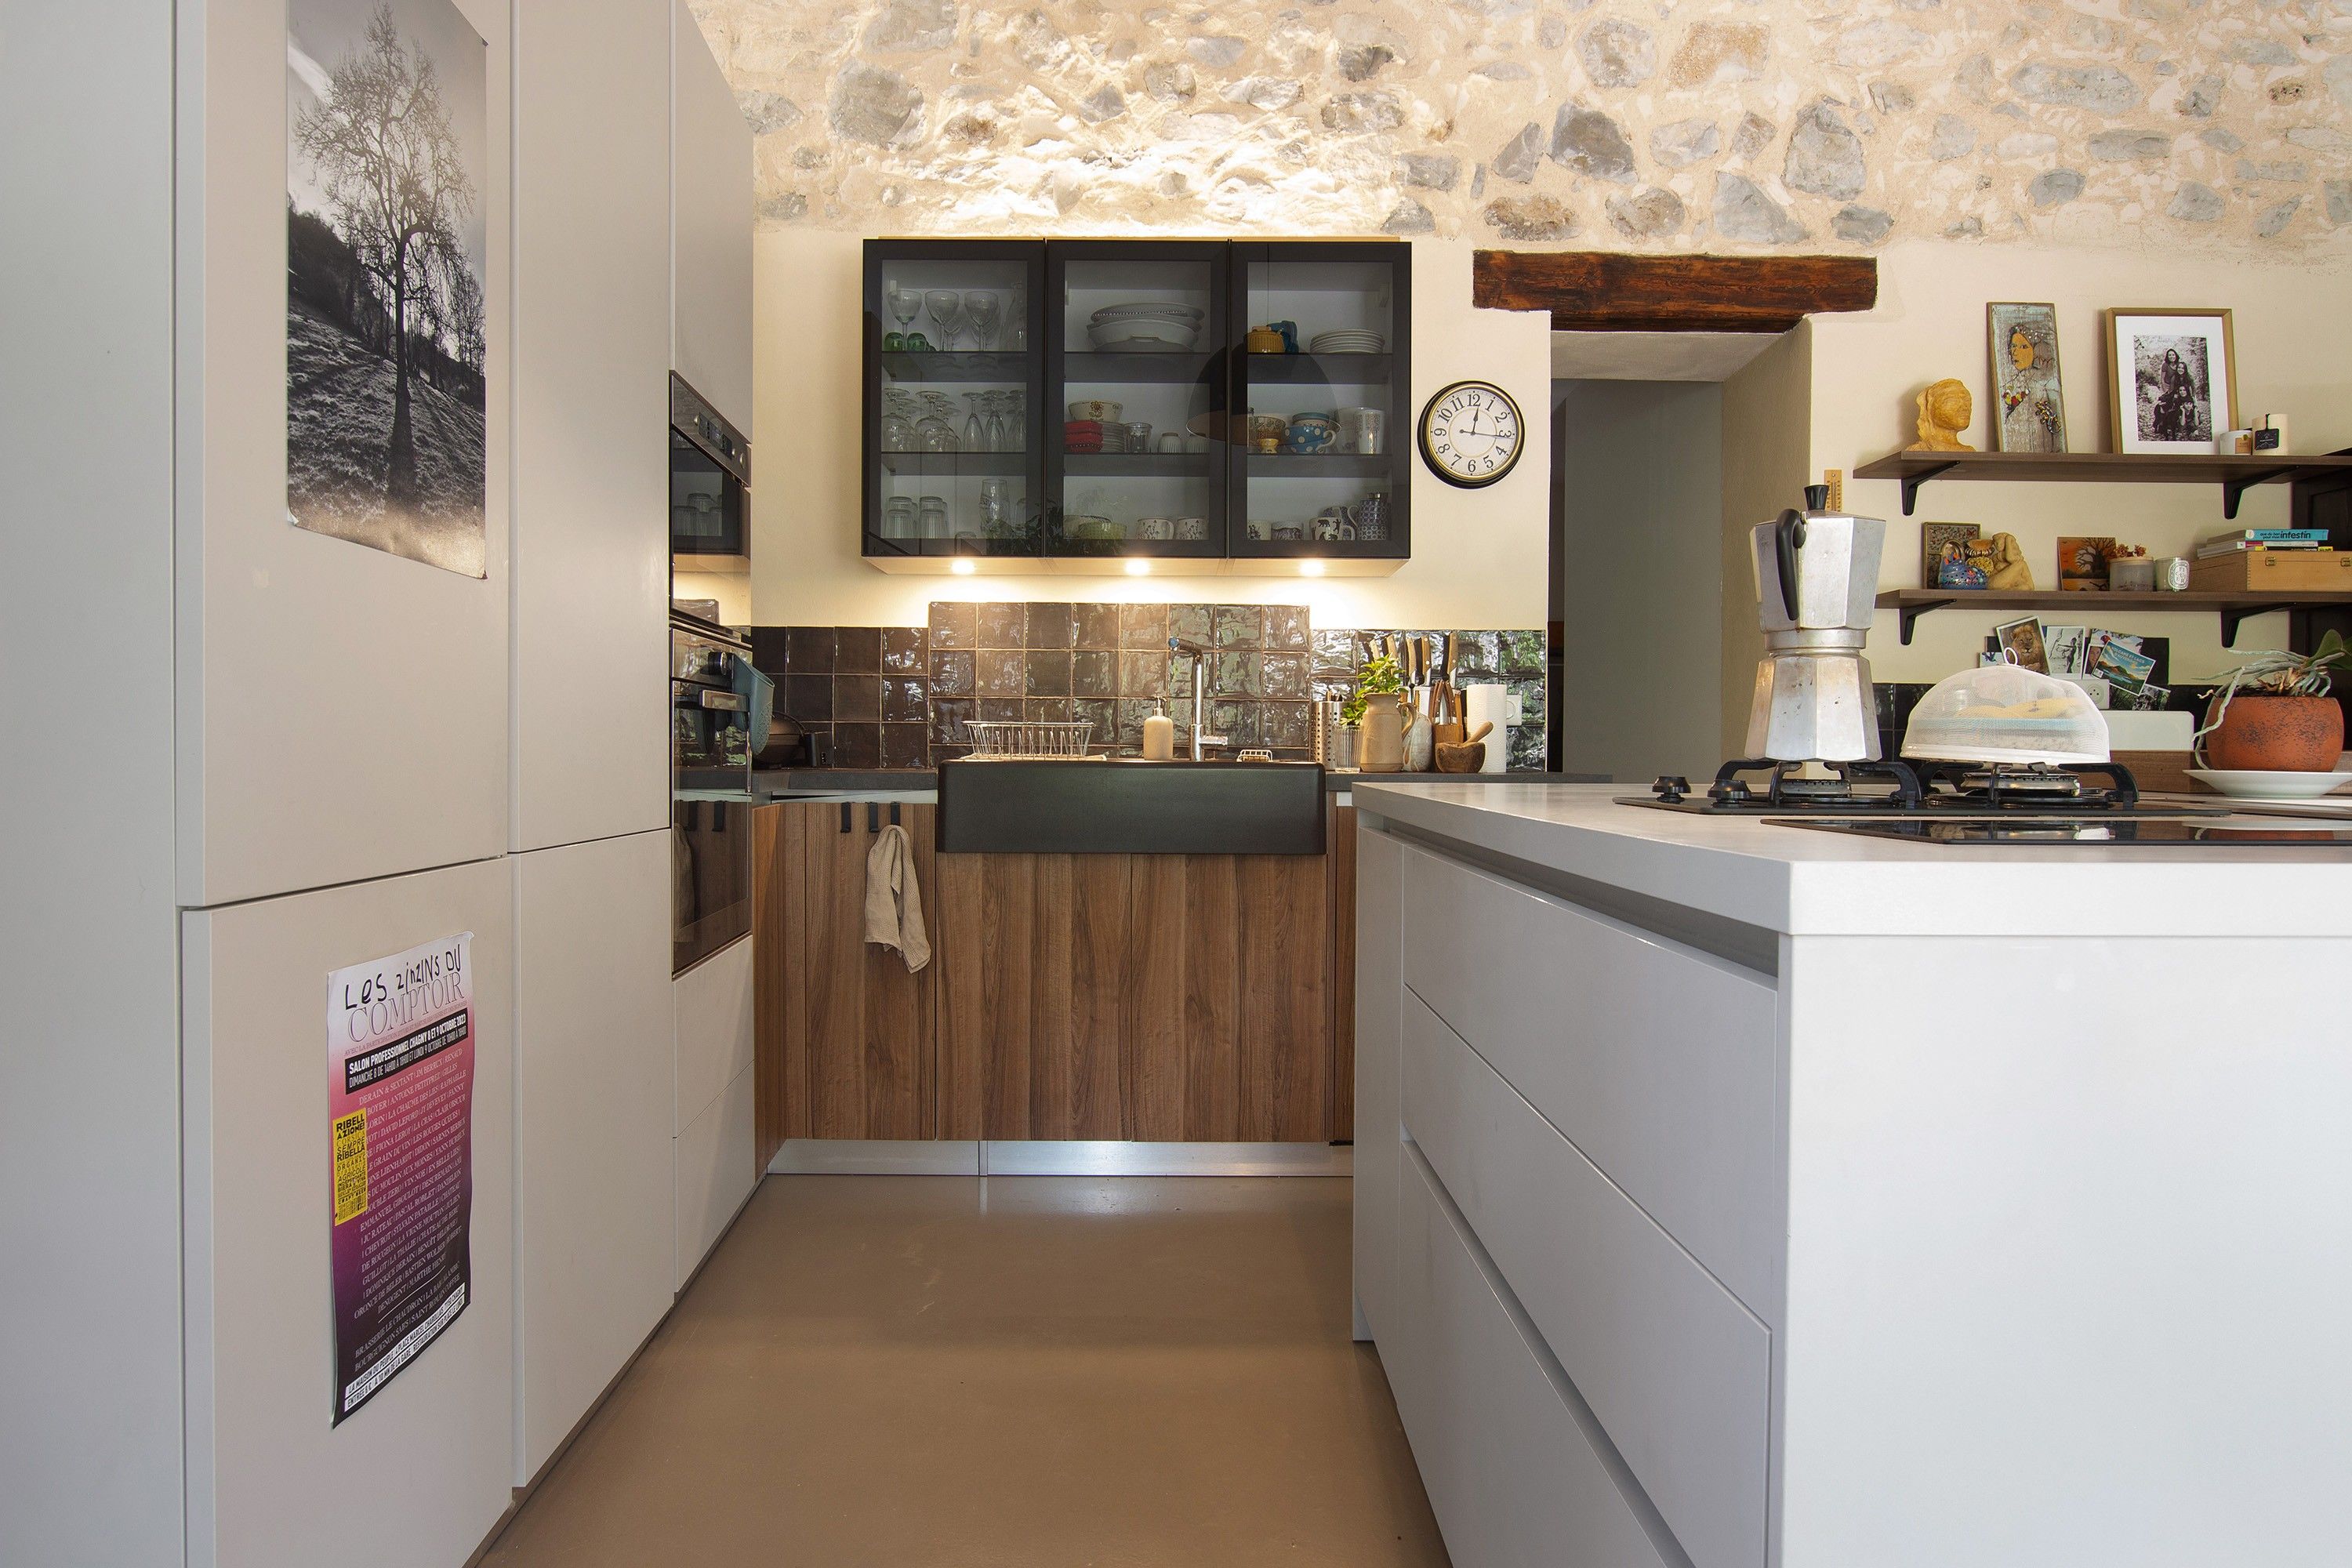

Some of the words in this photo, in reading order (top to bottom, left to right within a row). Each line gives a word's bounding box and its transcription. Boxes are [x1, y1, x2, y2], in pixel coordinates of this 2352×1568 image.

[1450, 397, 1465, 412] 11
[1467, 394, 1481, 406] 12
[1485, 399, 1495, 412] 1
[1438, 408, 1453, 423] 10
[1495, 412, 1507, 423] 2
[1434, 428, 1446, 437] 9
[1438, 443, 1450, 454] 8
[1496, 445, 1507, 456] 4
[1450, 455, 1462, 467] 7
[1468, 459, 1476, 472] 6
[1483, 456, 1494, 469] 5
[2280, 531, 2311, 539] intestin
[445, 944, 461, 972] DU
[348, 972, 464, 1042] COMPTOIR
[349, 1056, 369, 1074] SALON
[371, 1040, 408, 1065] PROFESSIONNEL
[409, 1032, 426, 1048] CHAGNY
[428, 1029, 430, 1040] 8
[431, 1027, 435, 1038] ET
[437, 1025, 438, 1036] 9
[440, 1017, 456, 1034] OCTOBRE
[457, 1013, 466, 1025] 2023
[349, 1069, 372, 1087] DIMANCHE
[378, 1065, 383, 1076] DE
[409, 1051, 413, 1061] ET
[428, 1037, 441, 1051] OCTOBRE
[359, 1087, 383, 1105] DERAIN
[384, 1083, 389, 1093] &
[390, 1073, 413, 1090] SEXTANT
[367, 1099, 387, 1116] BOYER
[390, 1085, 414, 1104] ANTOINE
[388, 1109, 396, 1119] LA
[397, 1096, 419, 1114] CHAUME
[336, 1112, 364, 1132] RIBELL
[381, 1120, 397, 1136] DAVID
[337, 1136, 365, 1154] SEMPRE
[376, 1136, 394, 1152] FIONA
[413, 1121, 419, 1131] LA
[337, 1142, 365, 1162] RIBELLA
[373, 1150, 393, 1167] GRAIN
[413, 1132, 422, 1143] LES
[337, 1153, 365, 1171] ORGANIC
[338, 1164, 365, 1183] AGRICOLE
[372, 1185, 378, 1196] DU
[379, 1171, 401, 1191] MOULIN
[402, 1163, 413, 1176] AUX
[338, 1193, 354, 1204] CRAFT
[365, 1193, 387, 1214] DOUBLE
[361, 1203, 392, 1232] EMMANUEL
[372, 1216, 393, 1238] RATEAU
[396, 1201, 414, 1221] PASCAL
[361, 1260, 369, 1272] DE
[399, 1233, 405, 1244] LA
[365, 1232, 390, 1256] CHEVROT
[362, 1261, 387, 1286] GUILLOT
[390, 1253, 396, 1265] LA
[396, 1251, 414, 1272] DERAIN
[393, 1294, 423, 1325] CHAUDRON
[349, 1382, 354, 1394] LA
[355, 1368, 372, 1388] MAISON
[398, 1335, 409, 1352] PLACE
[395, 1356, 400, 1367] LA
[401, 1348, 411, 1362] GARE
